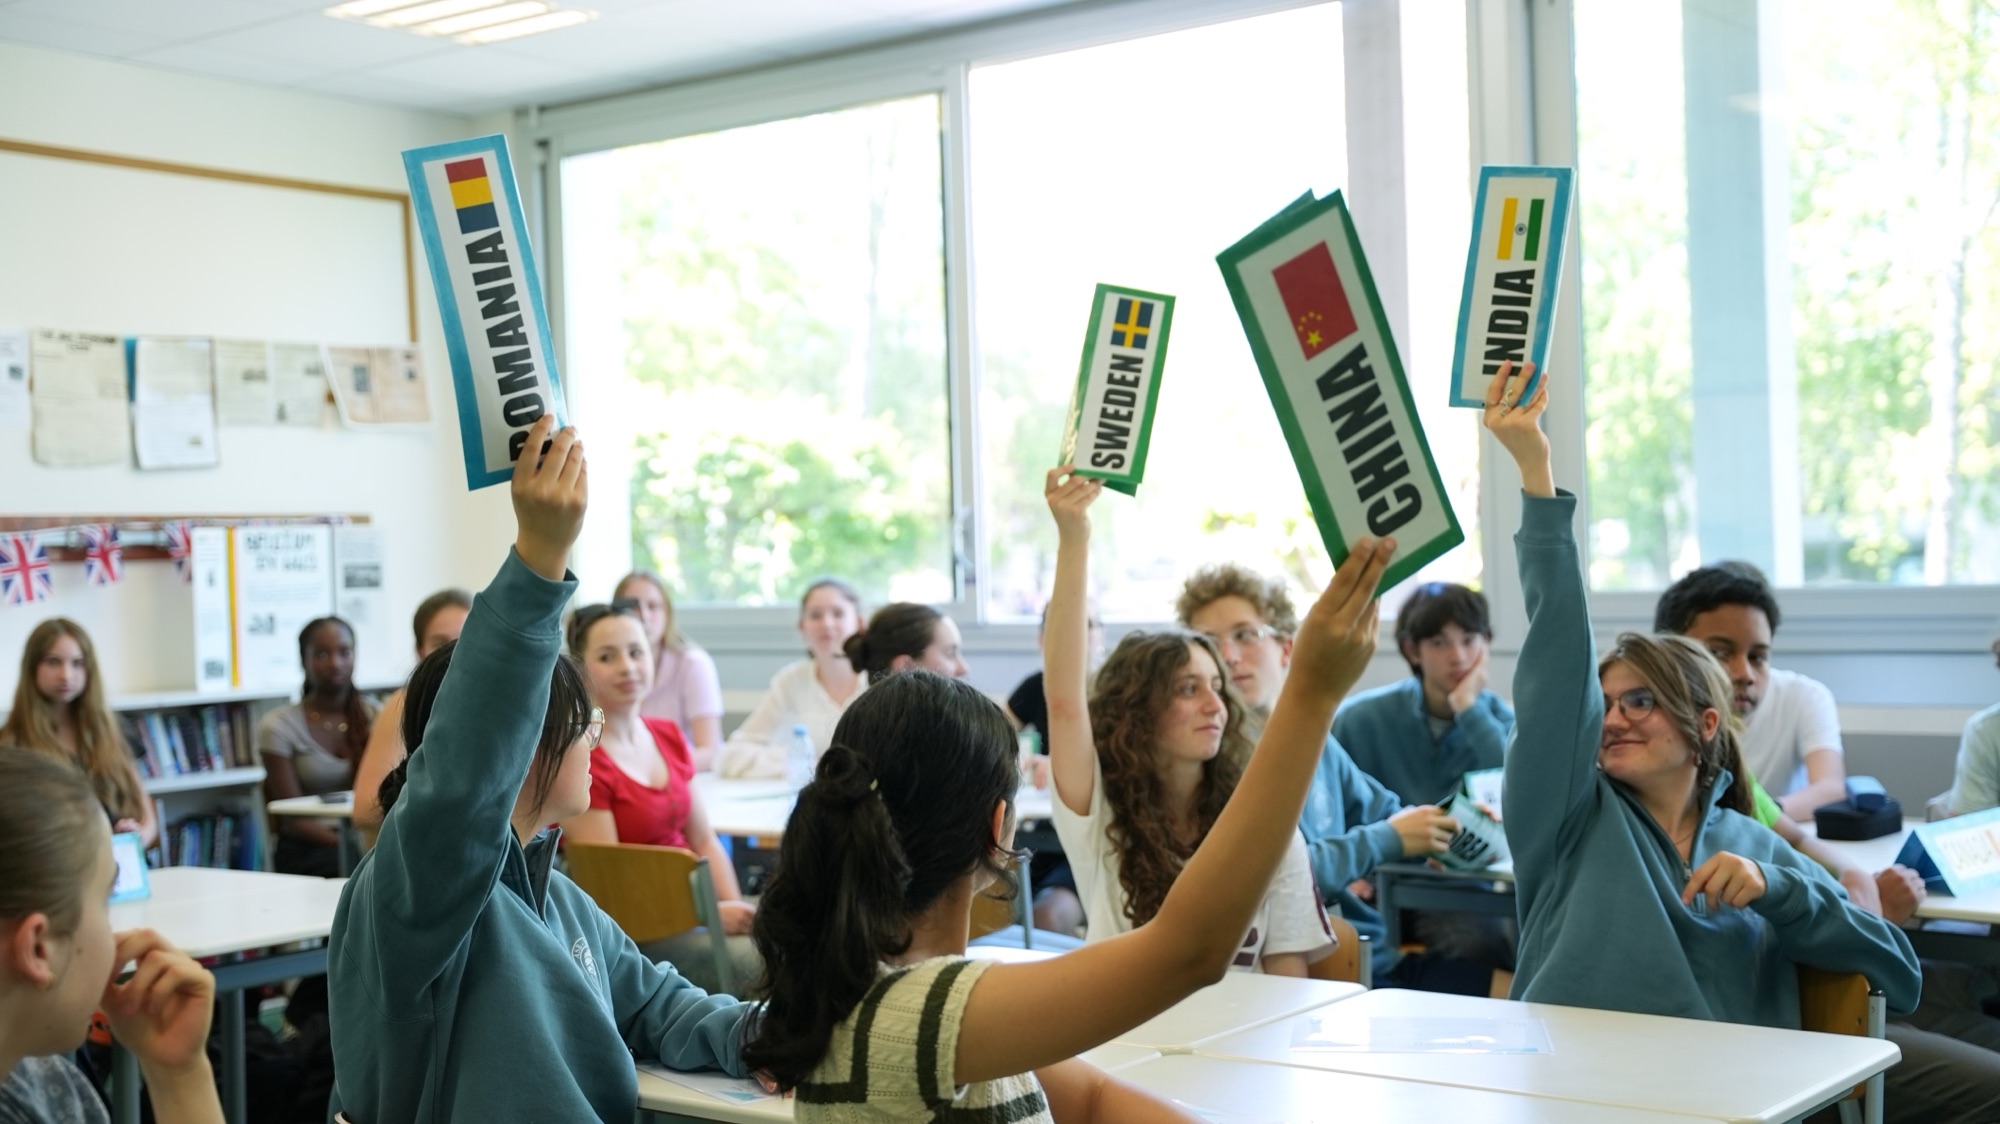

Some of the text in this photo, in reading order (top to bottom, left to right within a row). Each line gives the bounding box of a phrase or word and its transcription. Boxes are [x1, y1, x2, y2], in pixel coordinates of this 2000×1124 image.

[465, 230, 553, 462] ROMANIA
[1482, 269, 1535, 377] INDIA
[1091, 353, 1144, 469] SWEDEN
[1316, 341, 1422, 537] CHINA
[1448, 827, 1489, 861] OREA
